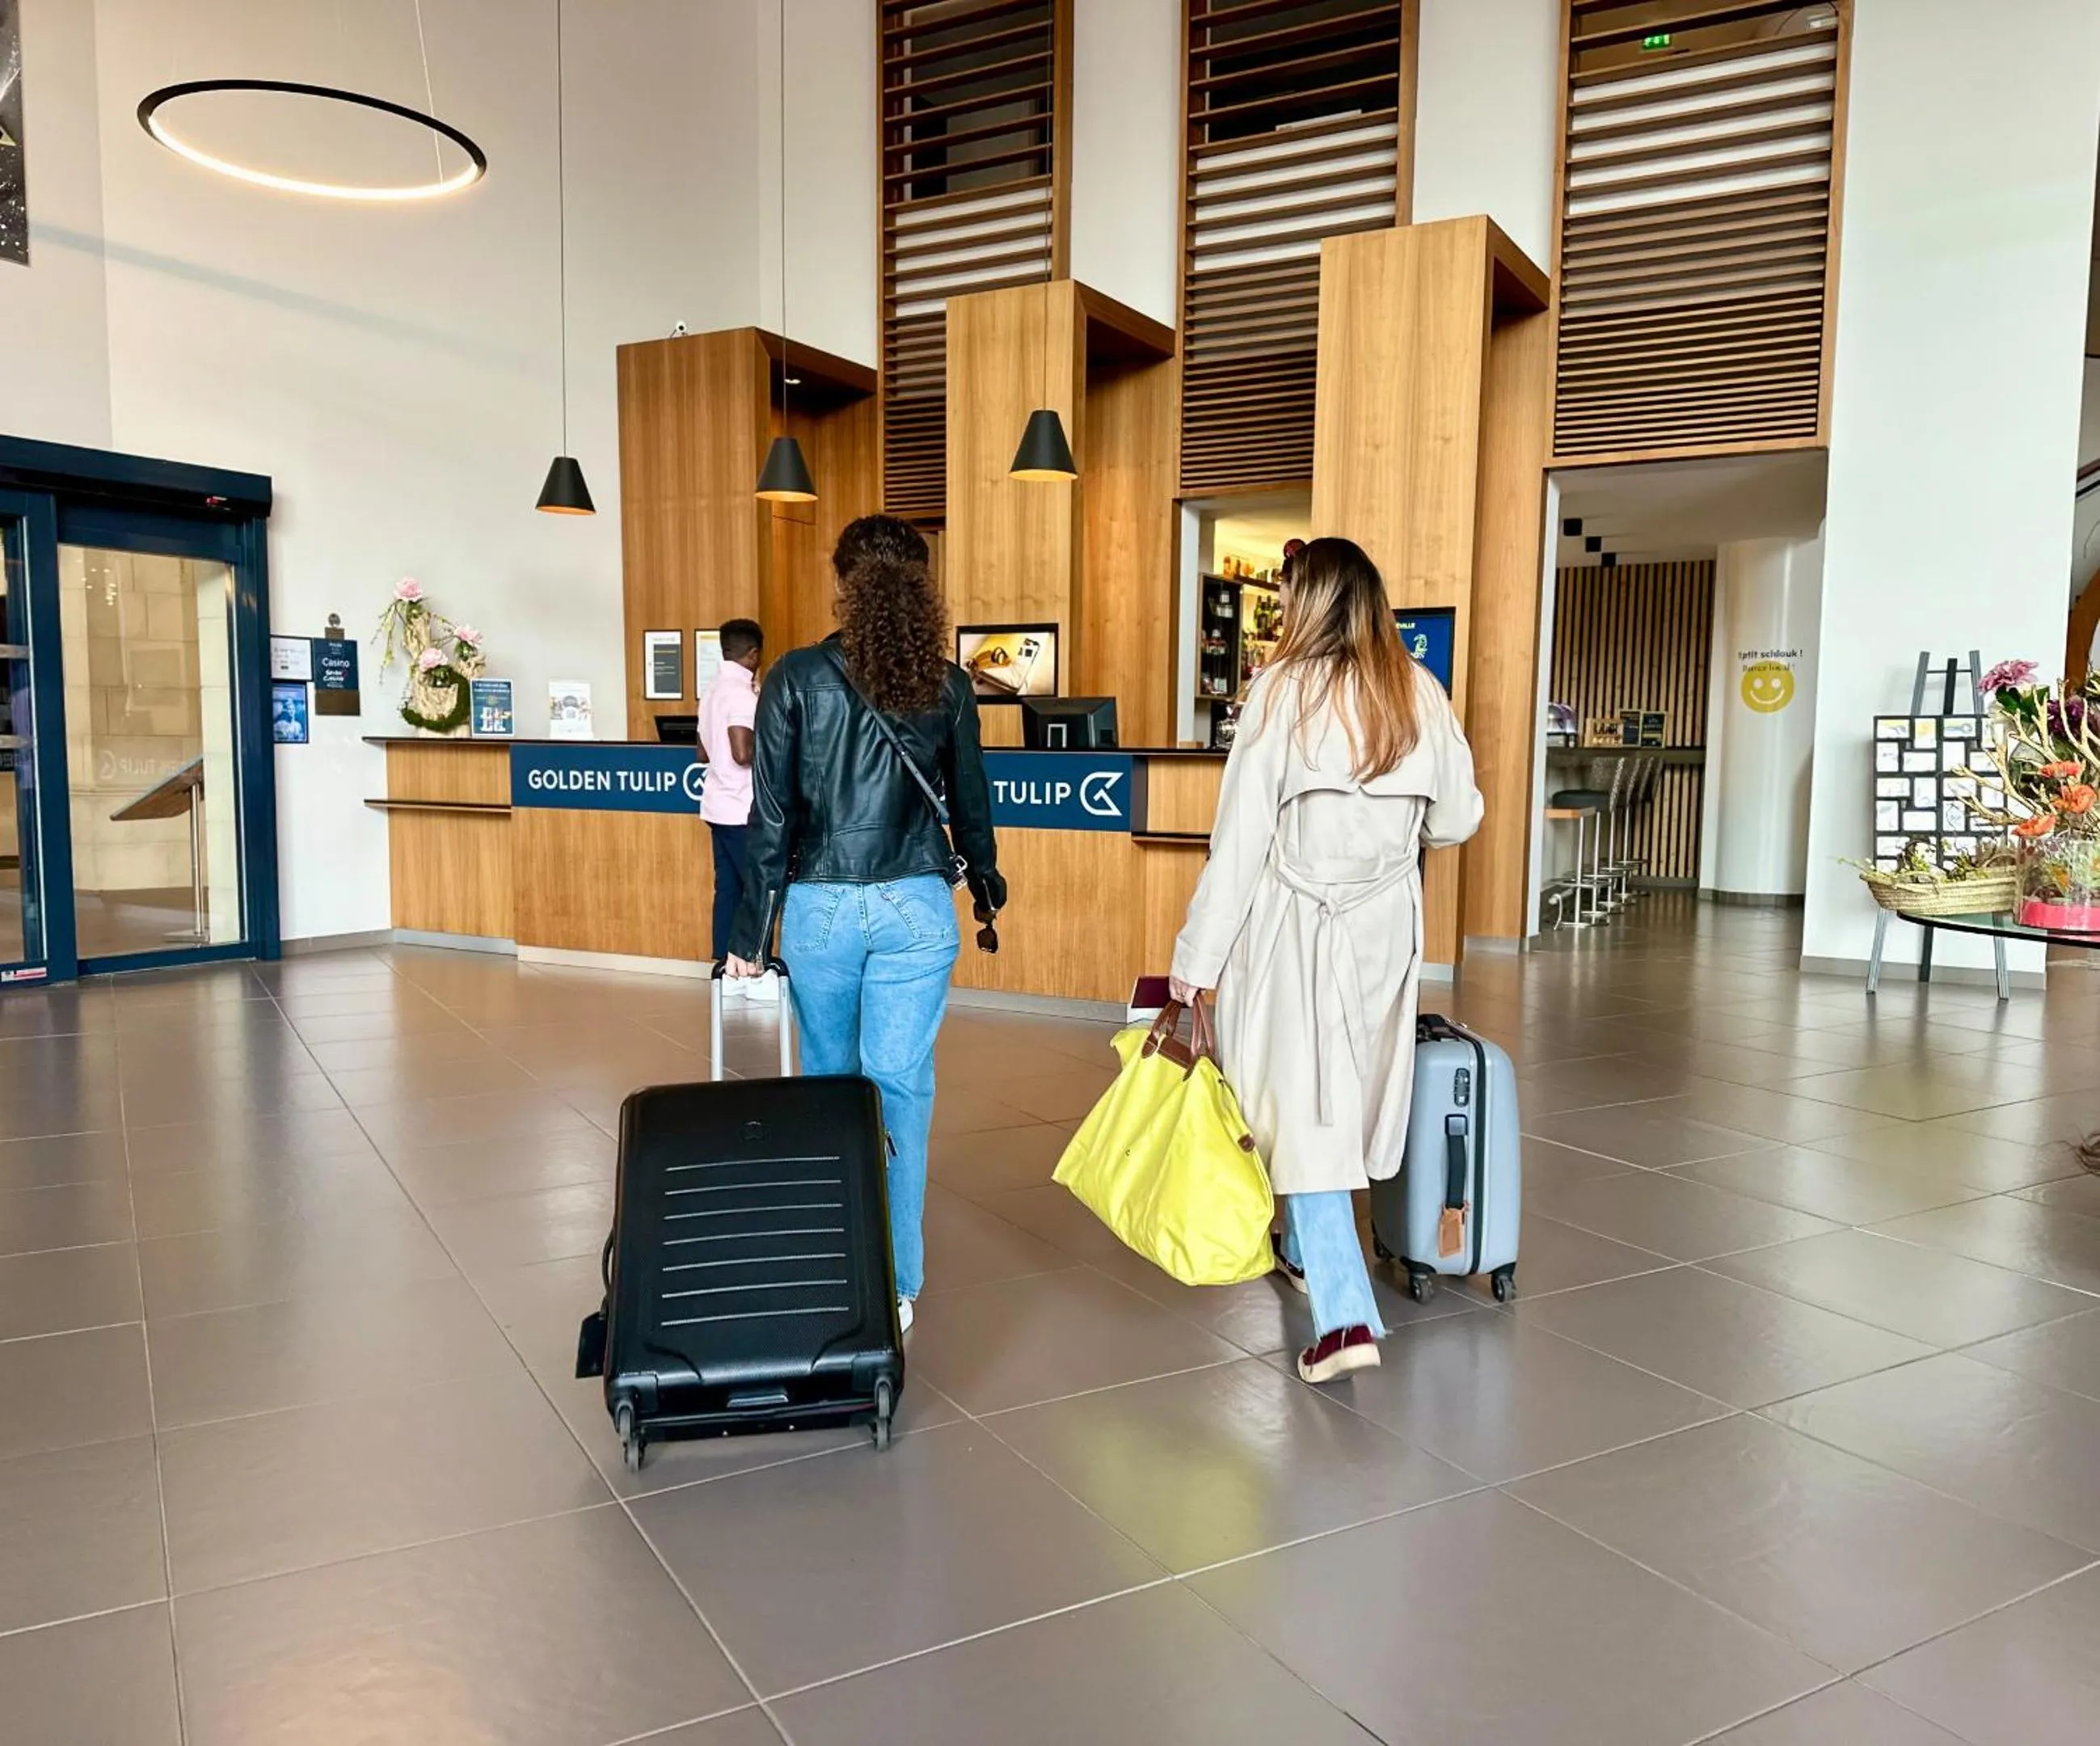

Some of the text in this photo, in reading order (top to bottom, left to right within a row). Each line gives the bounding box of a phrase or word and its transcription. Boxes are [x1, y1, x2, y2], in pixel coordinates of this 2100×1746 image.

[322, 657, 351, 668] Casino
[529, 769, 677, 791] GOLDEN TULIP
[993, 781, 1072, 805] TULIP
